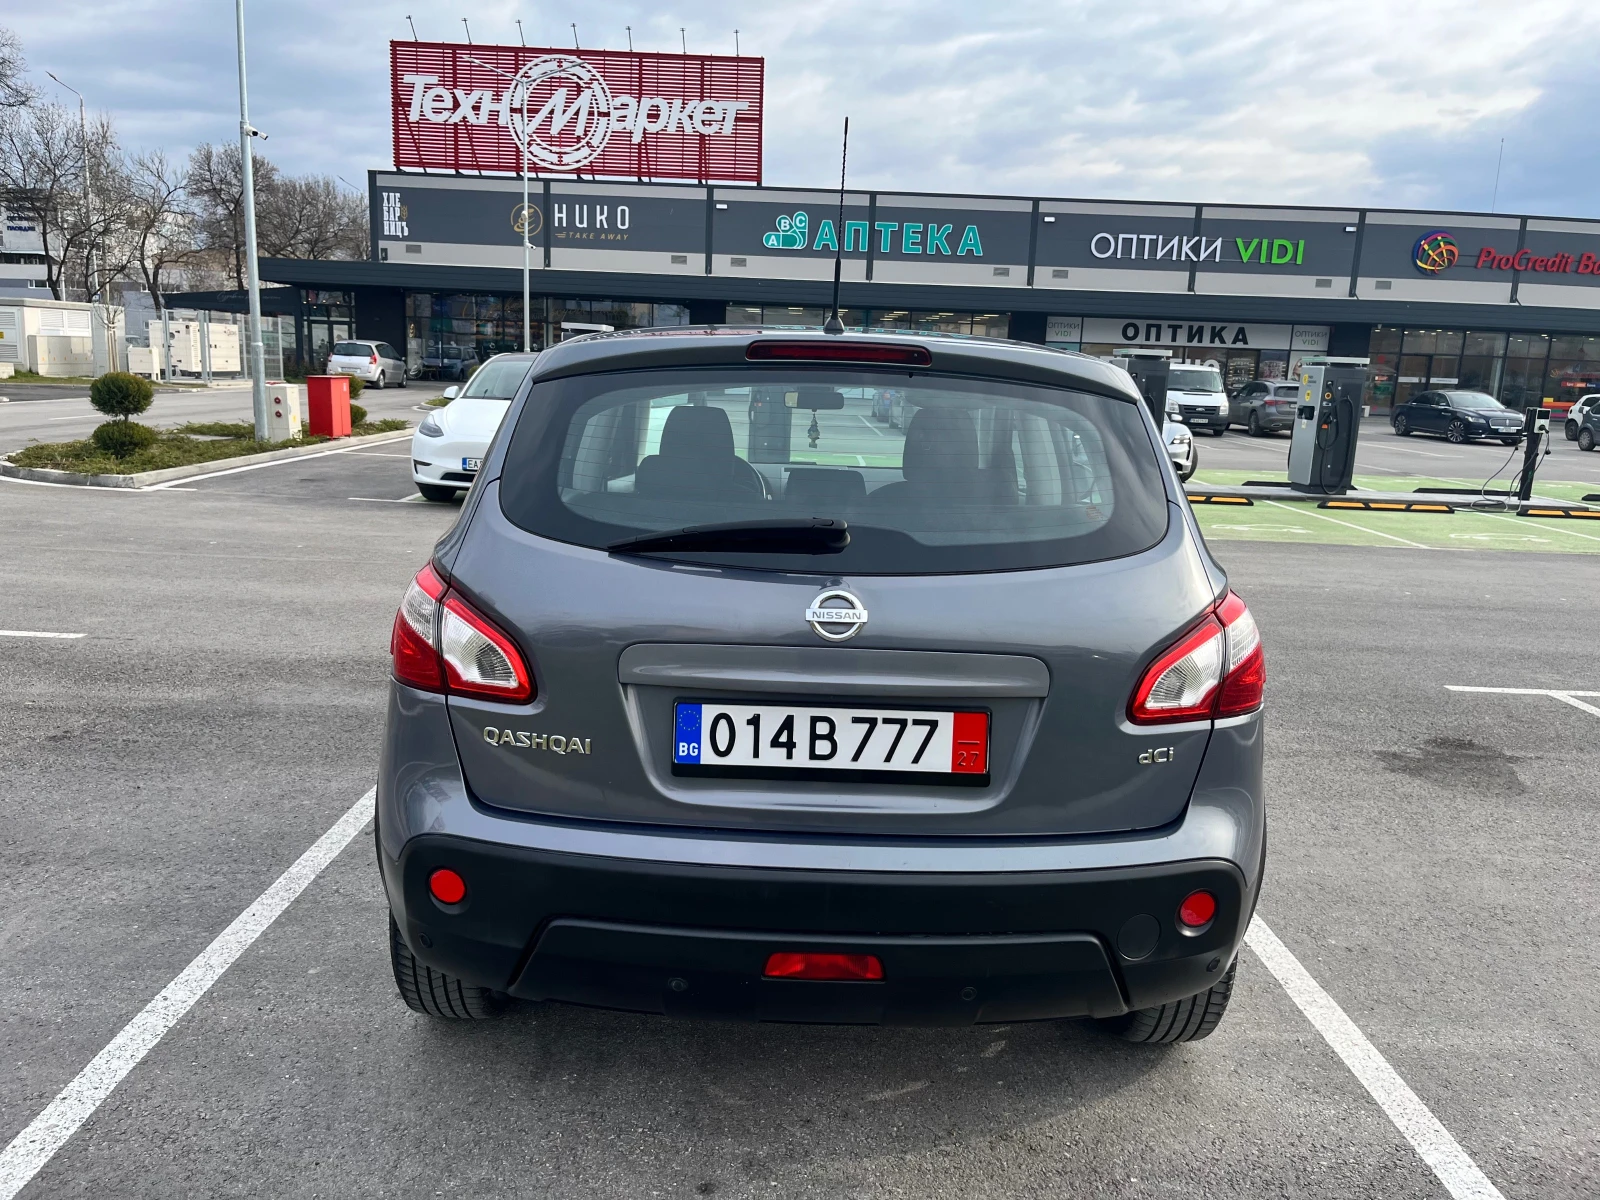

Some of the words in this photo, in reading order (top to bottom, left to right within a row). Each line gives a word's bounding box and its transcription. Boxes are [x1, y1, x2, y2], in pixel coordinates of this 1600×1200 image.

[382, 192, 401, 207] ХЛЕ
[383, 206, 401, 221] БАР
[383, 221, 409, 238] НИЦЪ
[569, 231, 595, 240] TAKE
[600, 233, 629, 241] AWAY
[813, 219, 983, 256] АПТЕКА
[1090, 232, 1222, 262] ОПТИКИ
[1235, 237, 1305, 265] VIDI
[1476, 247, 1575, 273] ProCredit
[1048, 321, 1080, 330] ОПТИКИ
[1121, 321, 1249, 346] ОПТИКА
[1294, 330, 1327, 338] ОПТИКИ
[1302, 338, 1319, 346] VIDI
[812, 611, 861, 620] NISSAN
[483, 726, 591, 755] QASHQAI
[678, 742, 699, 756] BG
[1138, 746, 1174, 765] dCi
[957, 750, 980, 766] 27
